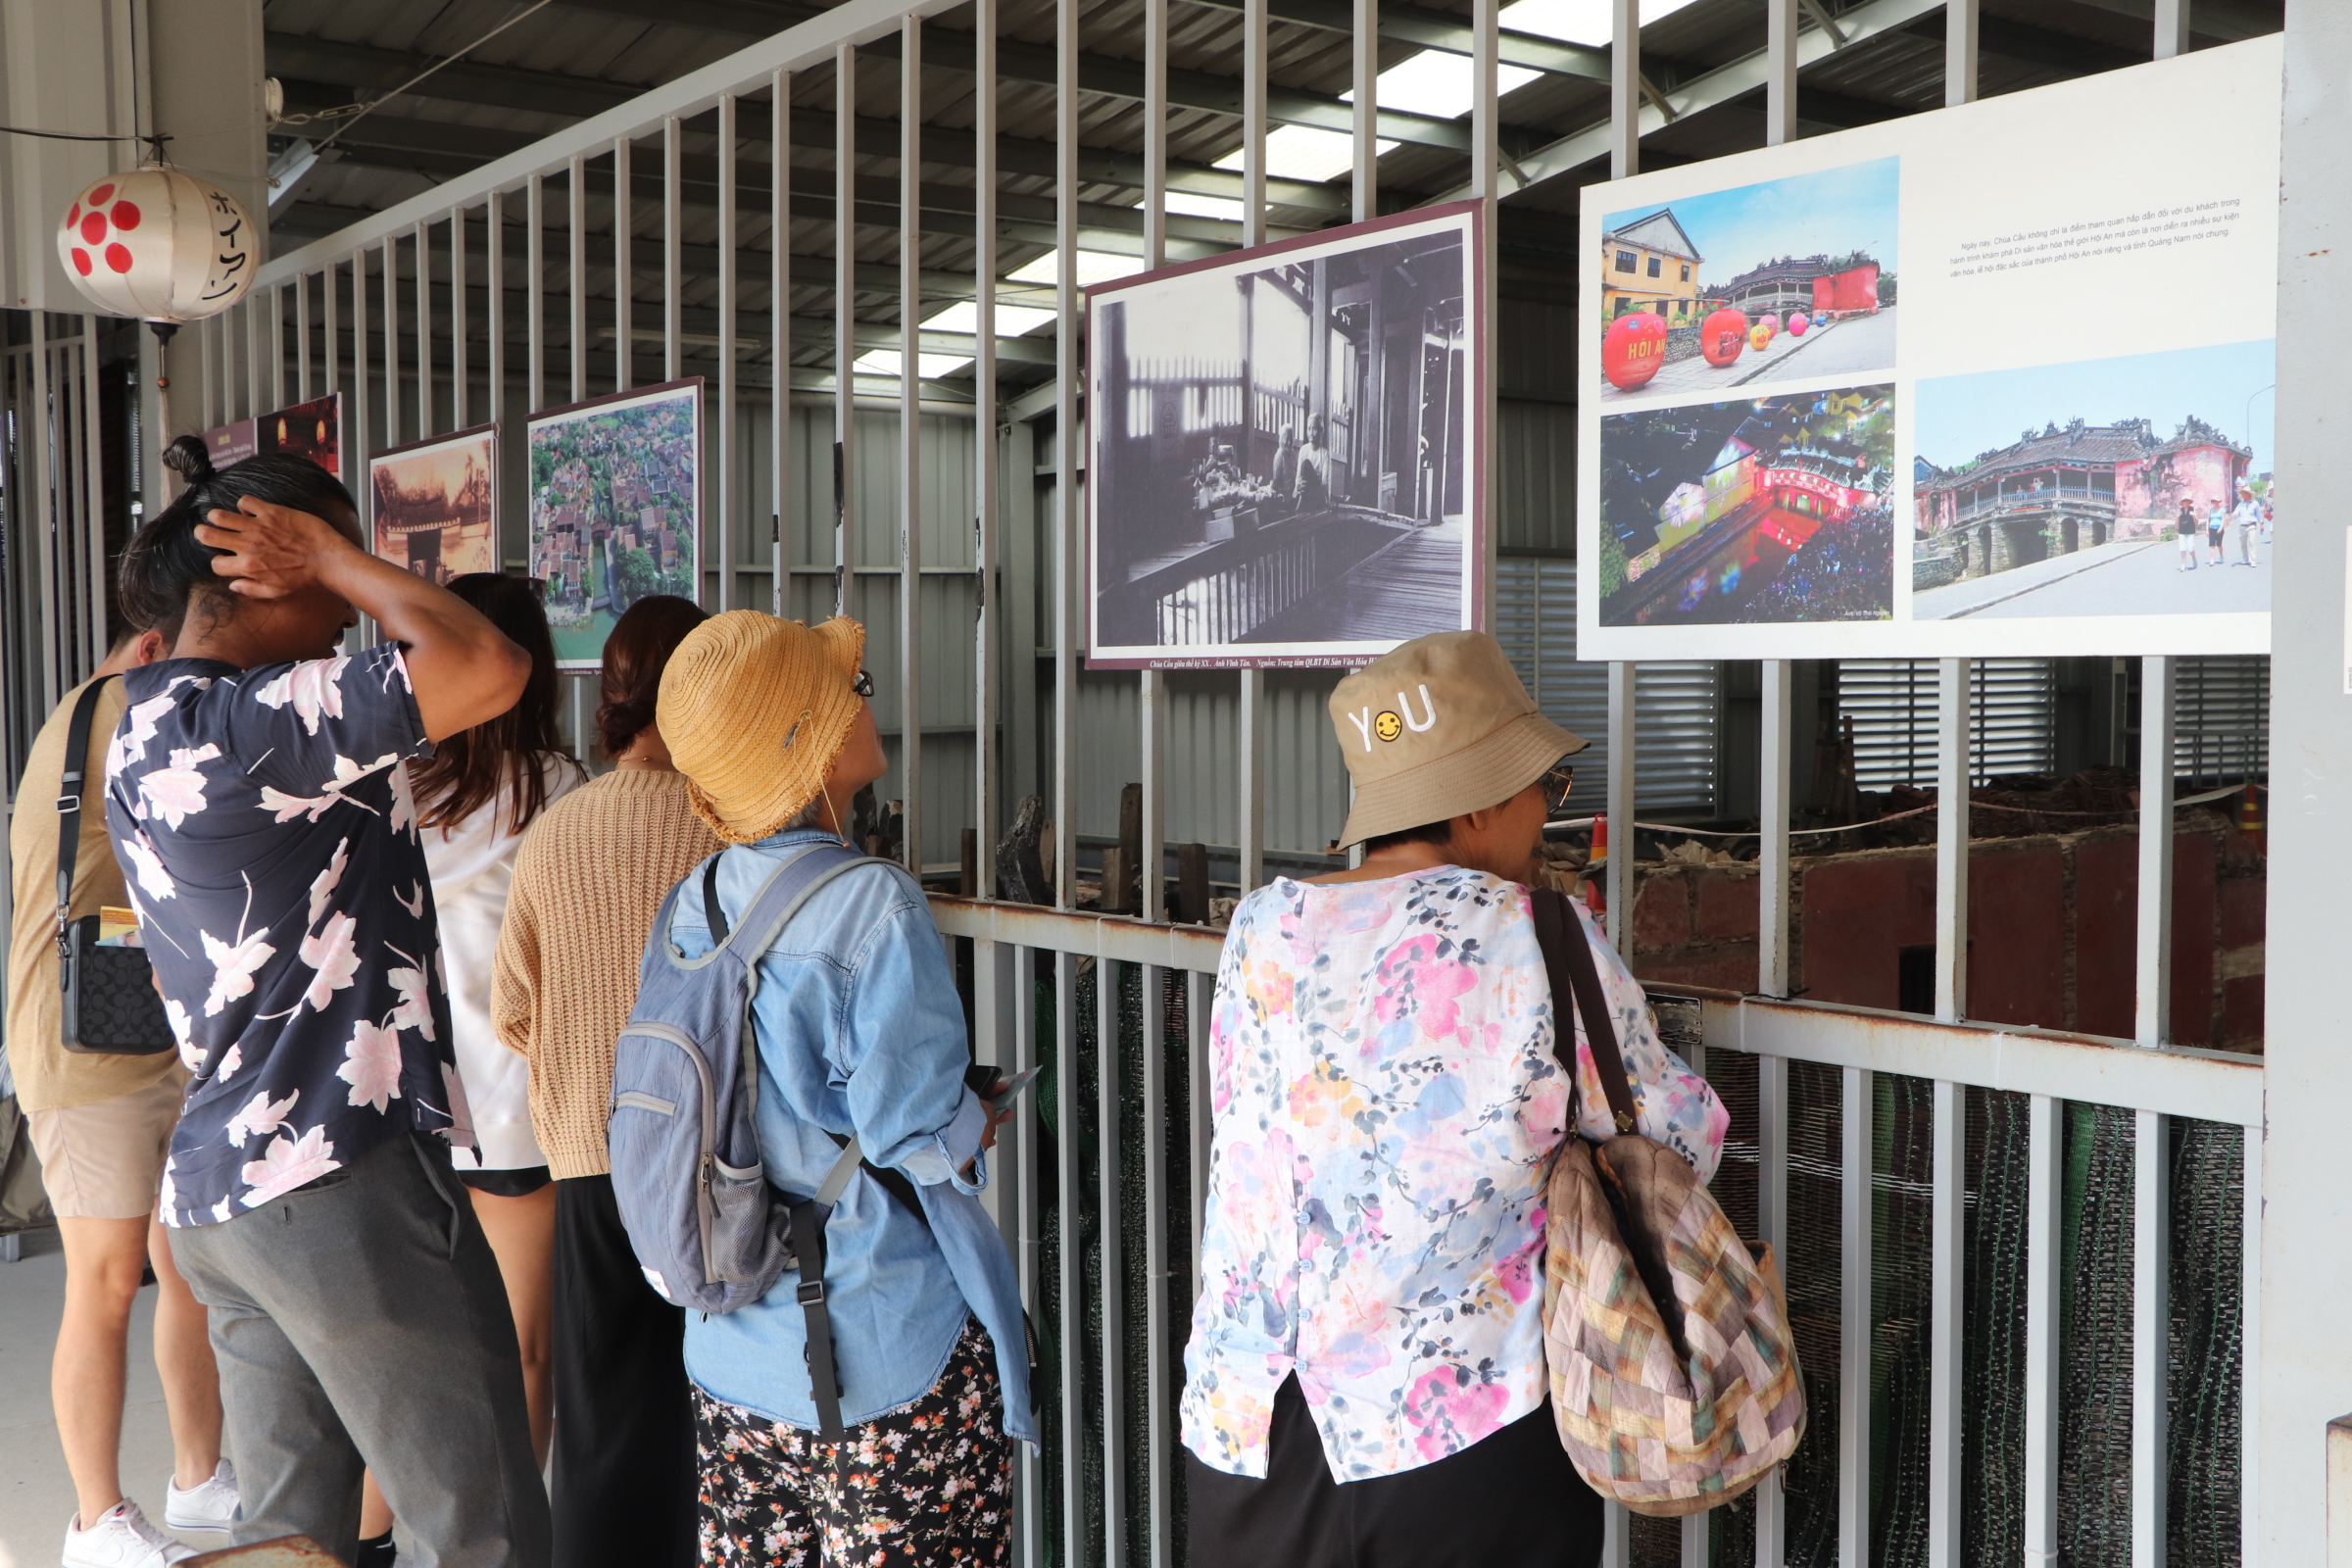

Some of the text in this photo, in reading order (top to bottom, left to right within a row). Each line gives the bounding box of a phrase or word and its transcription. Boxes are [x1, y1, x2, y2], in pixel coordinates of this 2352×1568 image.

[1961, 243, 1977, 252] Ngày
[2028, 230, 2047, 239] không
[2088, 220, 2105, 229] tham
[2107, 218, 2124, 226] quan
[2127, 214, 2139, 223] hấp
[2158, 209, 2169, 218] đối
[2171, 207, 2181, 216] với
[2196, 201, 2218, 212] khách
[2221, 198, 2240, 207] trong
[2001, 250, 2013, 259] phá
[2064, 238, 2075, 247] thế
[2077, 236, 2089, 246] giới
[2115, 230, 2125, 239] mà
[2128, 228, 2139, 237] còn
[2164, 220, 2179, 231] diễn
[2190, 215, 2210, 226] nhiều
[1984, 264, 1994, 272] hội
[2034, 256, 2052, 265] thành
[2055, 252, 2067, 263] phố
[2069, 251, 2080, 260] Hội
[2104, 245, 2121, 254] riêng
[2174, 233, 2190, 243] Nam
[1628, 337, 1652, 361] HỘI
[1304, 658, 1321, 668] QLBT
